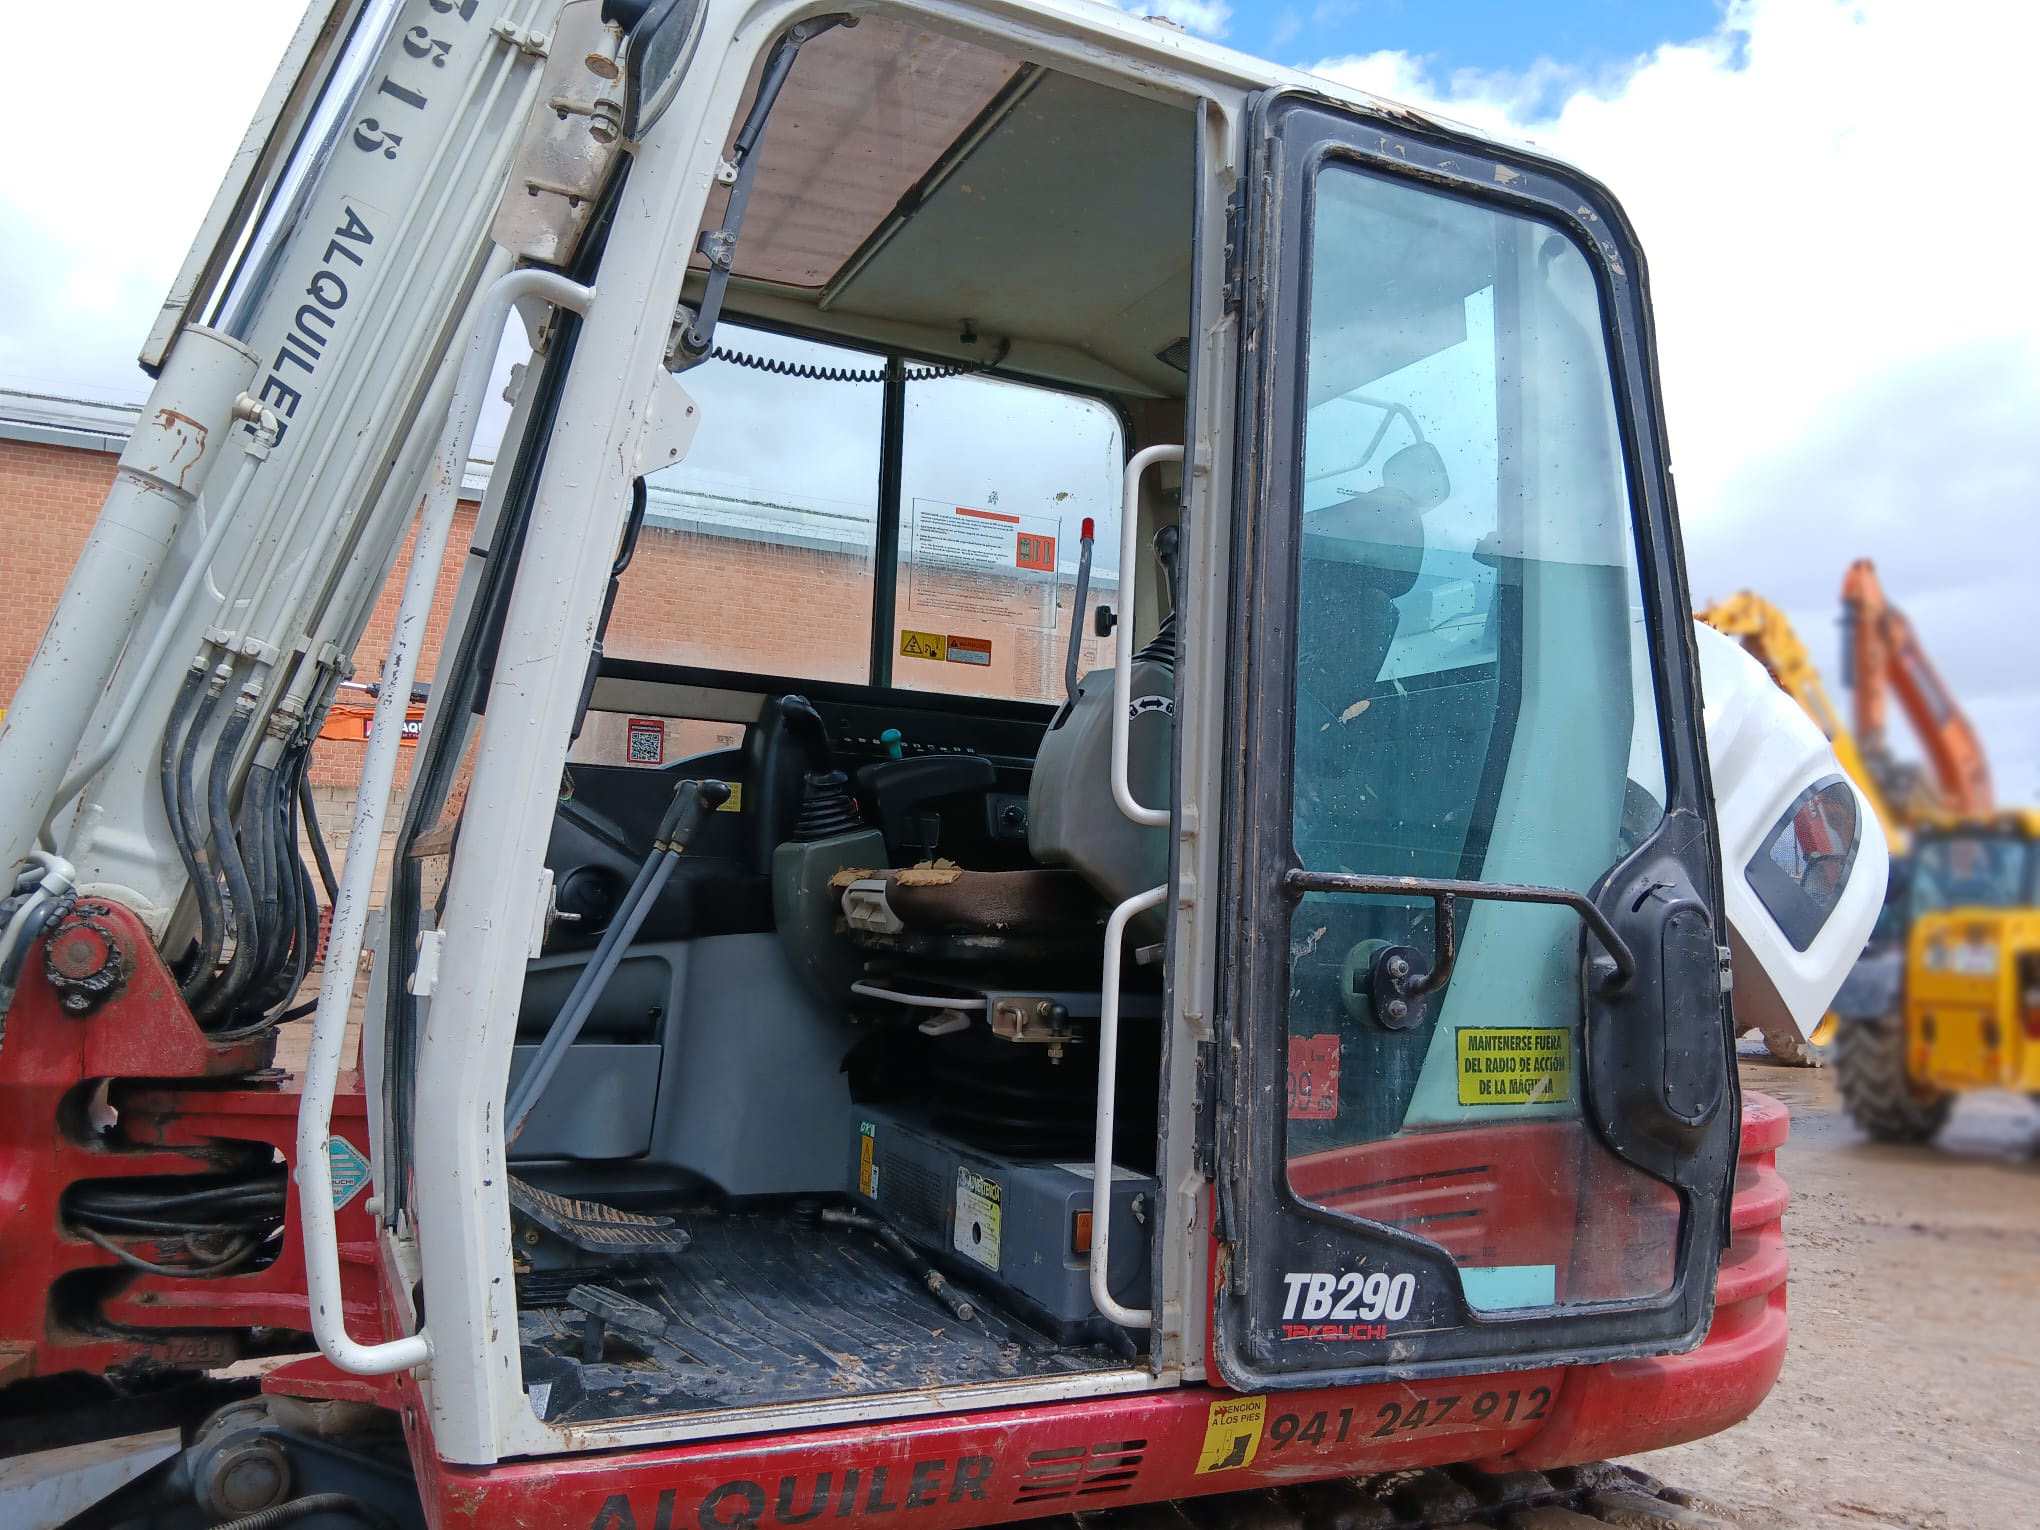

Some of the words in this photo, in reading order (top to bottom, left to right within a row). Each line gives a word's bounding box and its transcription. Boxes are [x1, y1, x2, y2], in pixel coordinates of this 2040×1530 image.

[1468, 1035, 1532, 1051] MANTENERSE
[1535, 1034, 1562, 1050] FUERA
[1464, 1057, 1482, 1073] DEL
[1485, 1057, 1516, 1073] RADIO
[1519, 1057, 1531, 1072] DE
[1479, 1079, 1492, 1095] DE
[1495, 1079, 1506, 1095] LA
[1282, 1272, 1416, 1321] TB290
[1282, 1324, 1387, 1340] TAKEUCHI
[1212, 1418, 1218, 1426] A
[1220, 1415, 1238, 1425] LOS
[1240, 1413, 1261, 1422] PIES
[1271, 1407, 1353, 1451] 941
[1370, 1396, 1463, 1438] 247
[1471, 1386, 1551, 1424] 912
